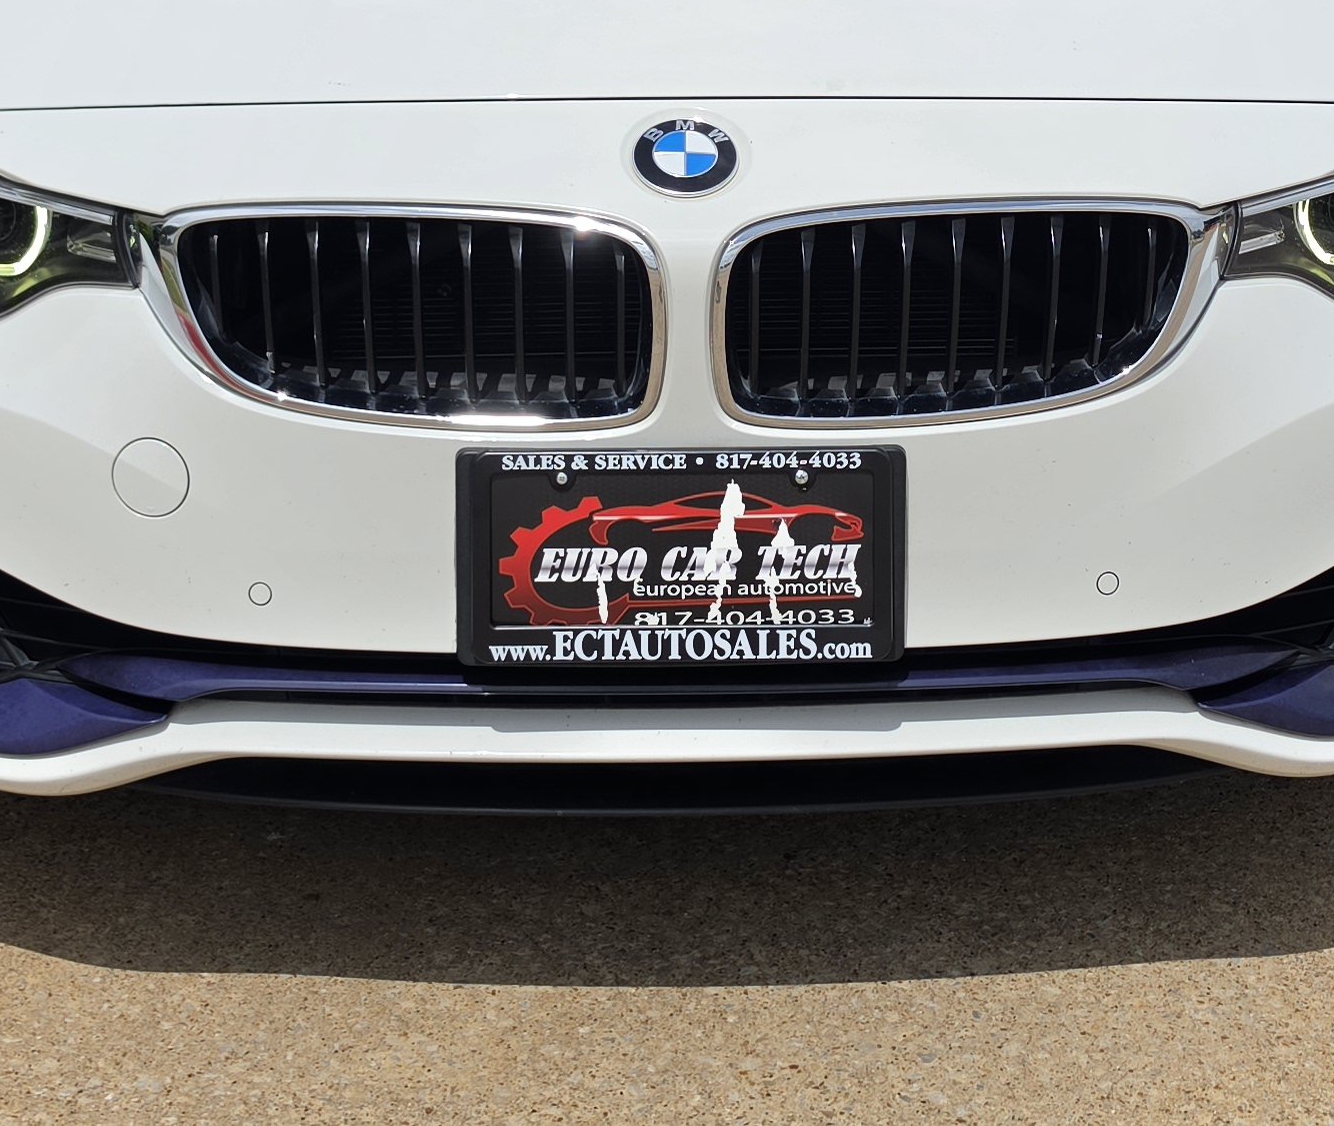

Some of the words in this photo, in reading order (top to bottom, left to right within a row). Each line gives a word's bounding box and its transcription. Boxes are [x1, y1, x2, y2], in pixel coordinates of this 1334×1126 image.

[643, 120, 730, 143] BMW
[501, 454, 566, 471] SALES
[570, 454, 589, 470] &
[594, 454, 687, 470] SERVICE
[715, 451, 862, 470] 817-404-4033
[534, 547, 648, 583] EURO
[660, 546, 743, 582] CAR
[755, 544, 861, 580] TECH
[634, 581, 732, 600] european
[737, 579, 858, 596] automotive
[634, 609, 855, 626] 817-404-4033
[489, 628, 873, 662] www.ECTAUTOSALES.com
